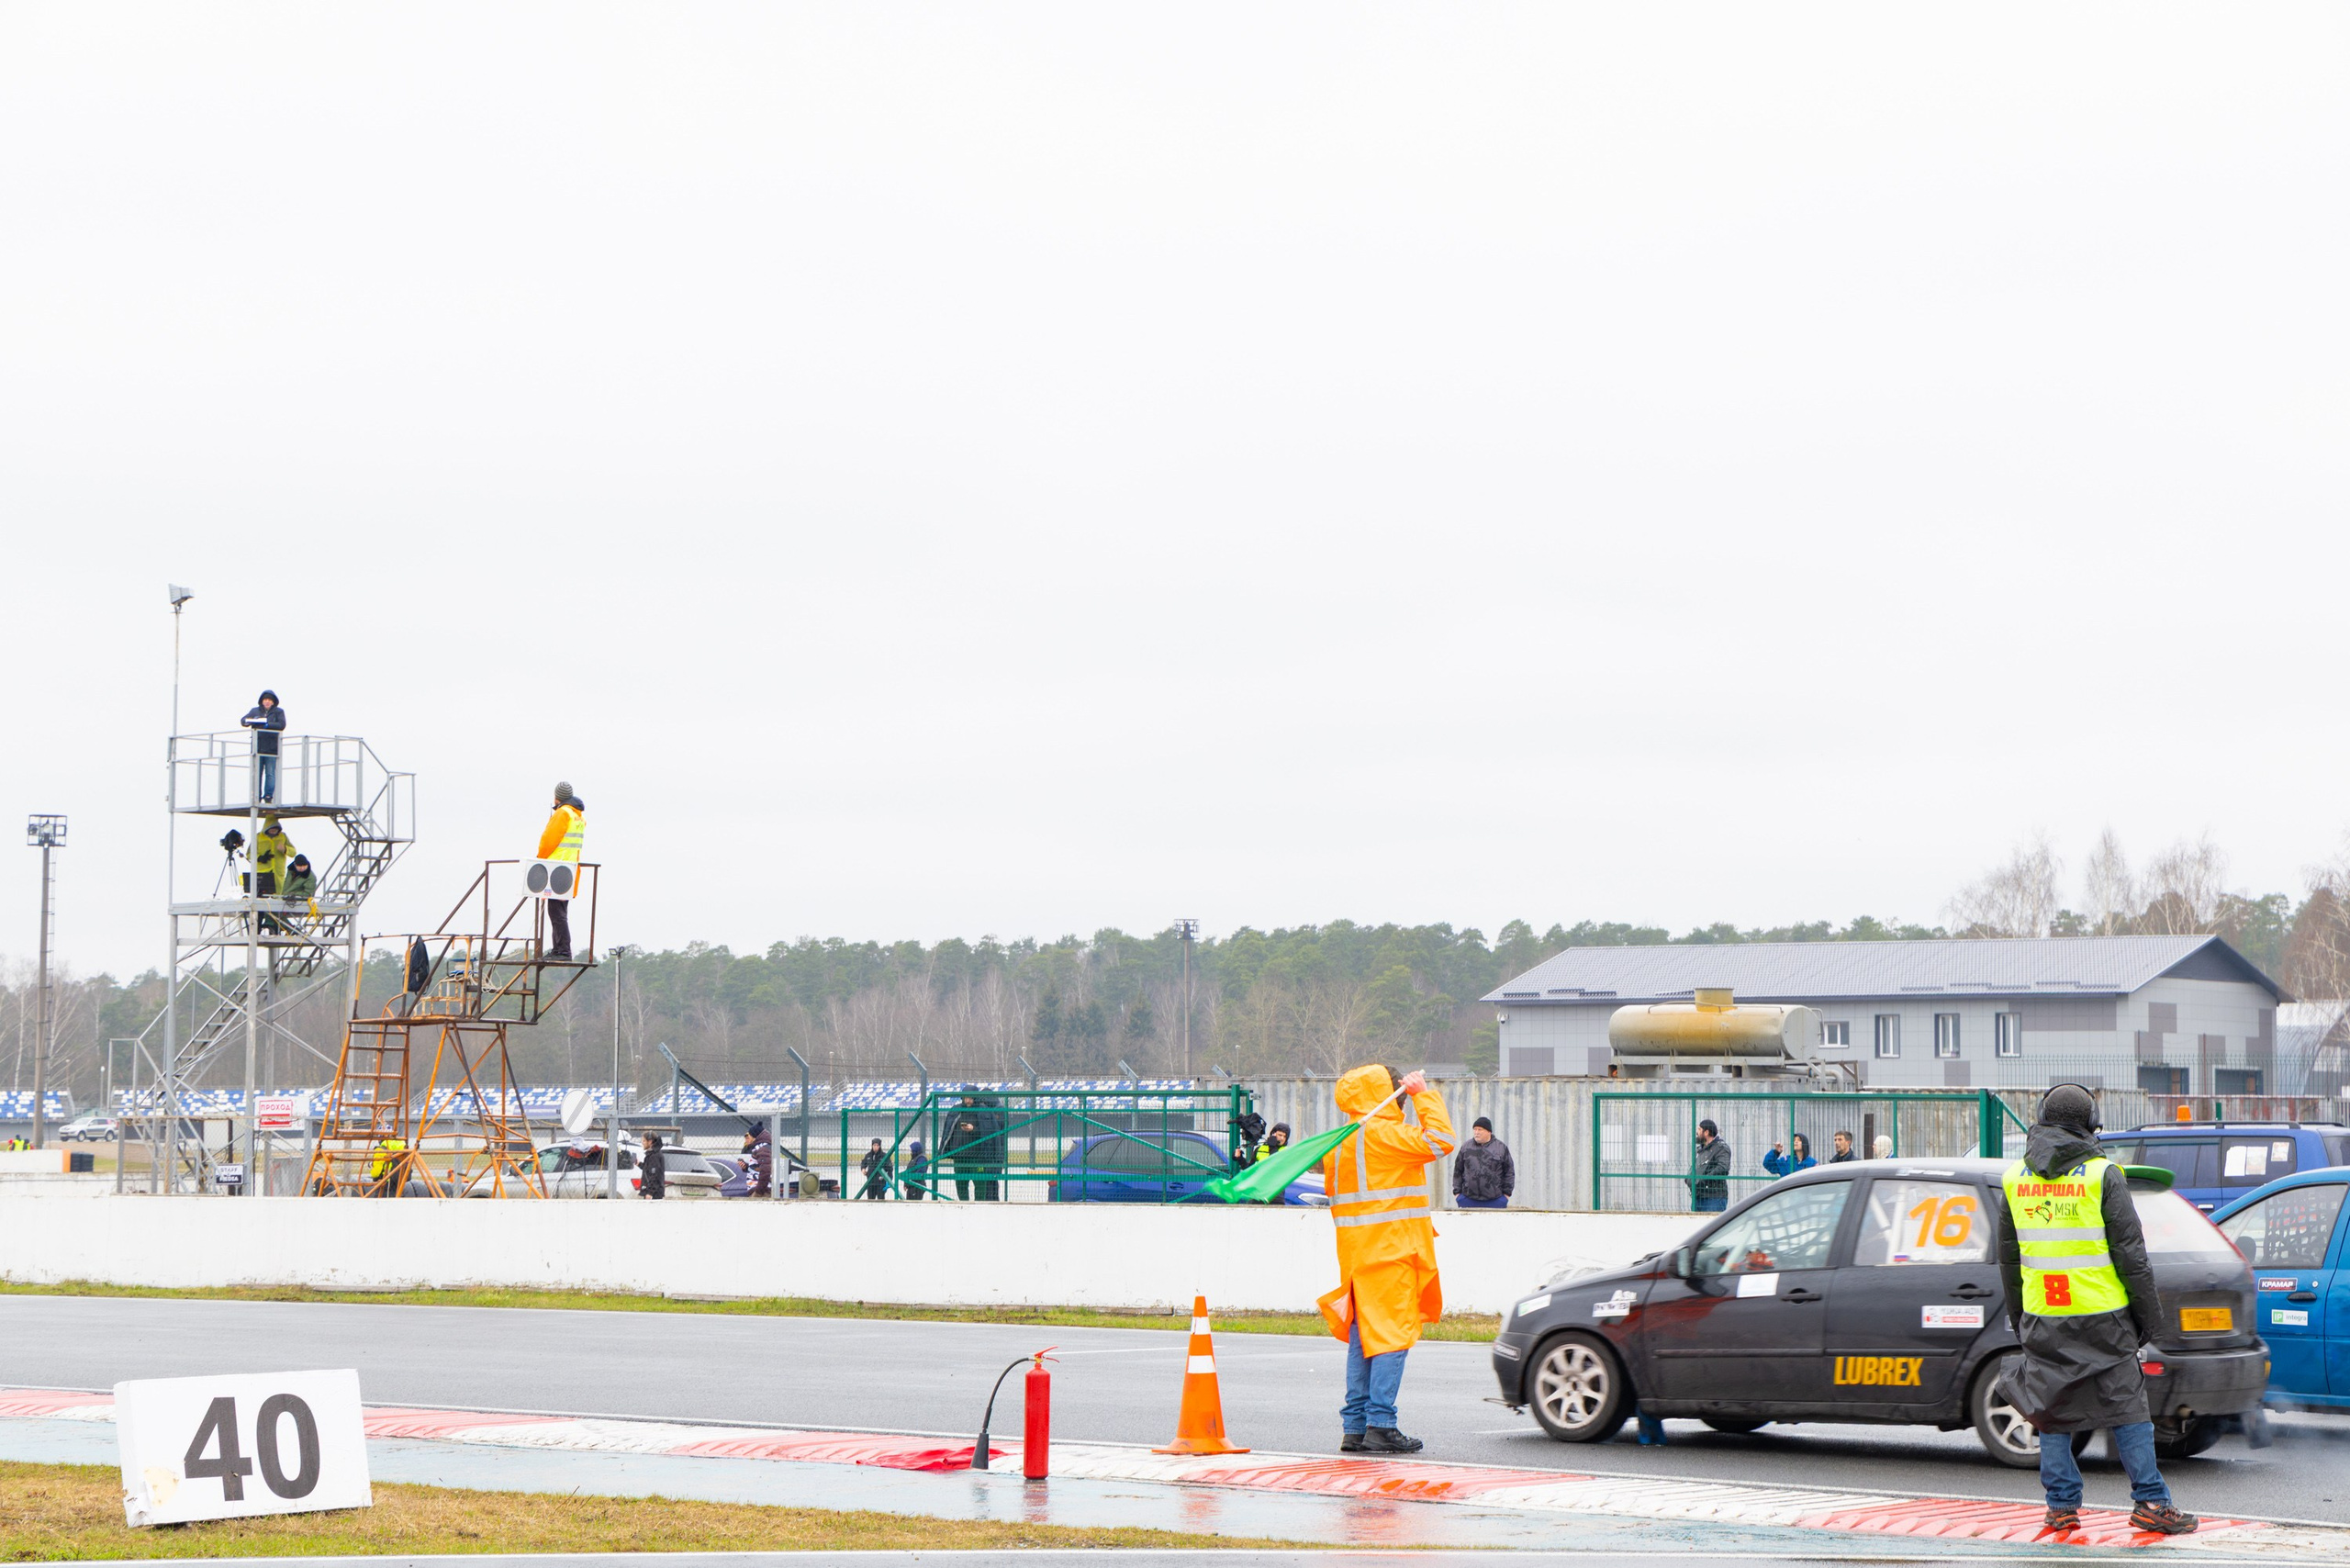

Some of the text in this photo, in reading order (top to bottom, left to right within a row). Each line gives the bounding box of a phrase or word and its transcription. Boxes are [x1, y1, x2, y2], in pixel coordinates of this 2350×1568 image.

[2017, 1183, 2087, 1197] МАРШАЛ
[1908, 1195, 1977, 1248] 16
[2055, 1203, 2078, 1215] MSK
[2043, 1273, 2072, 1306] 8
[1833, 1356, 1924, 1386] LUBREX
[184, 1393, 320, 1500] 40
